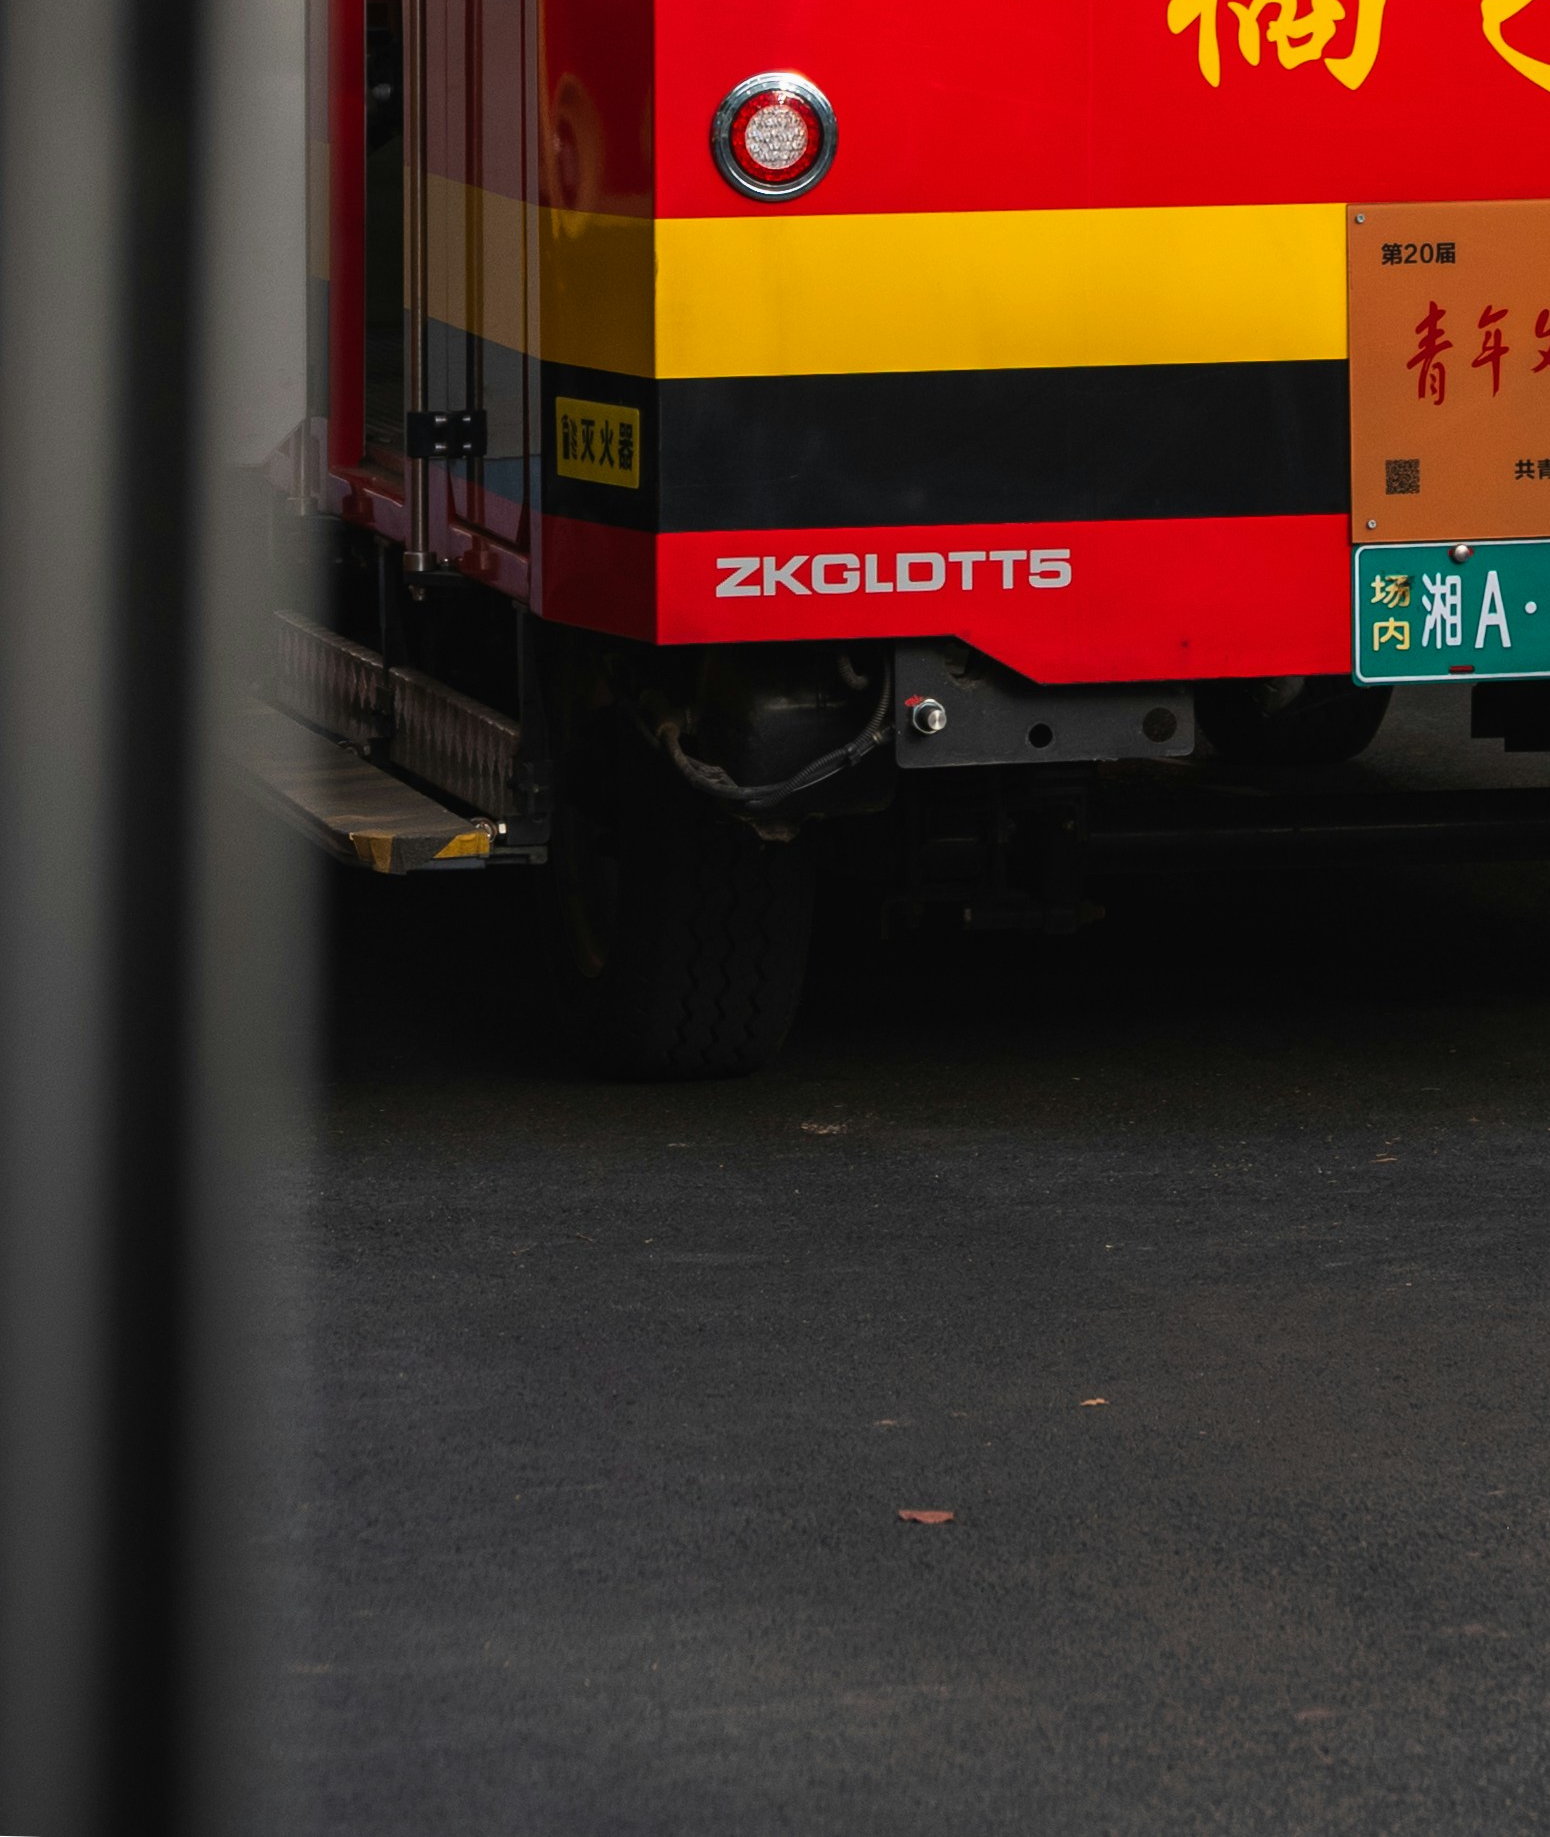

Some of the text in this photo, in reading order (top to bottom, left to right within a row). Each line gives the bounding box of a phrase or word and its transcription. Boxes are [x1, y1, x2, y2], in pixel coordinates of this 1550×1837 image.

[1381, 242, 1456, 266] 第20届
[580, 418, 634, 471] 灭火器
[715, 549, 1072, 598] ZKGLDTT5
[1371, 574, 1411, 651] 场内
